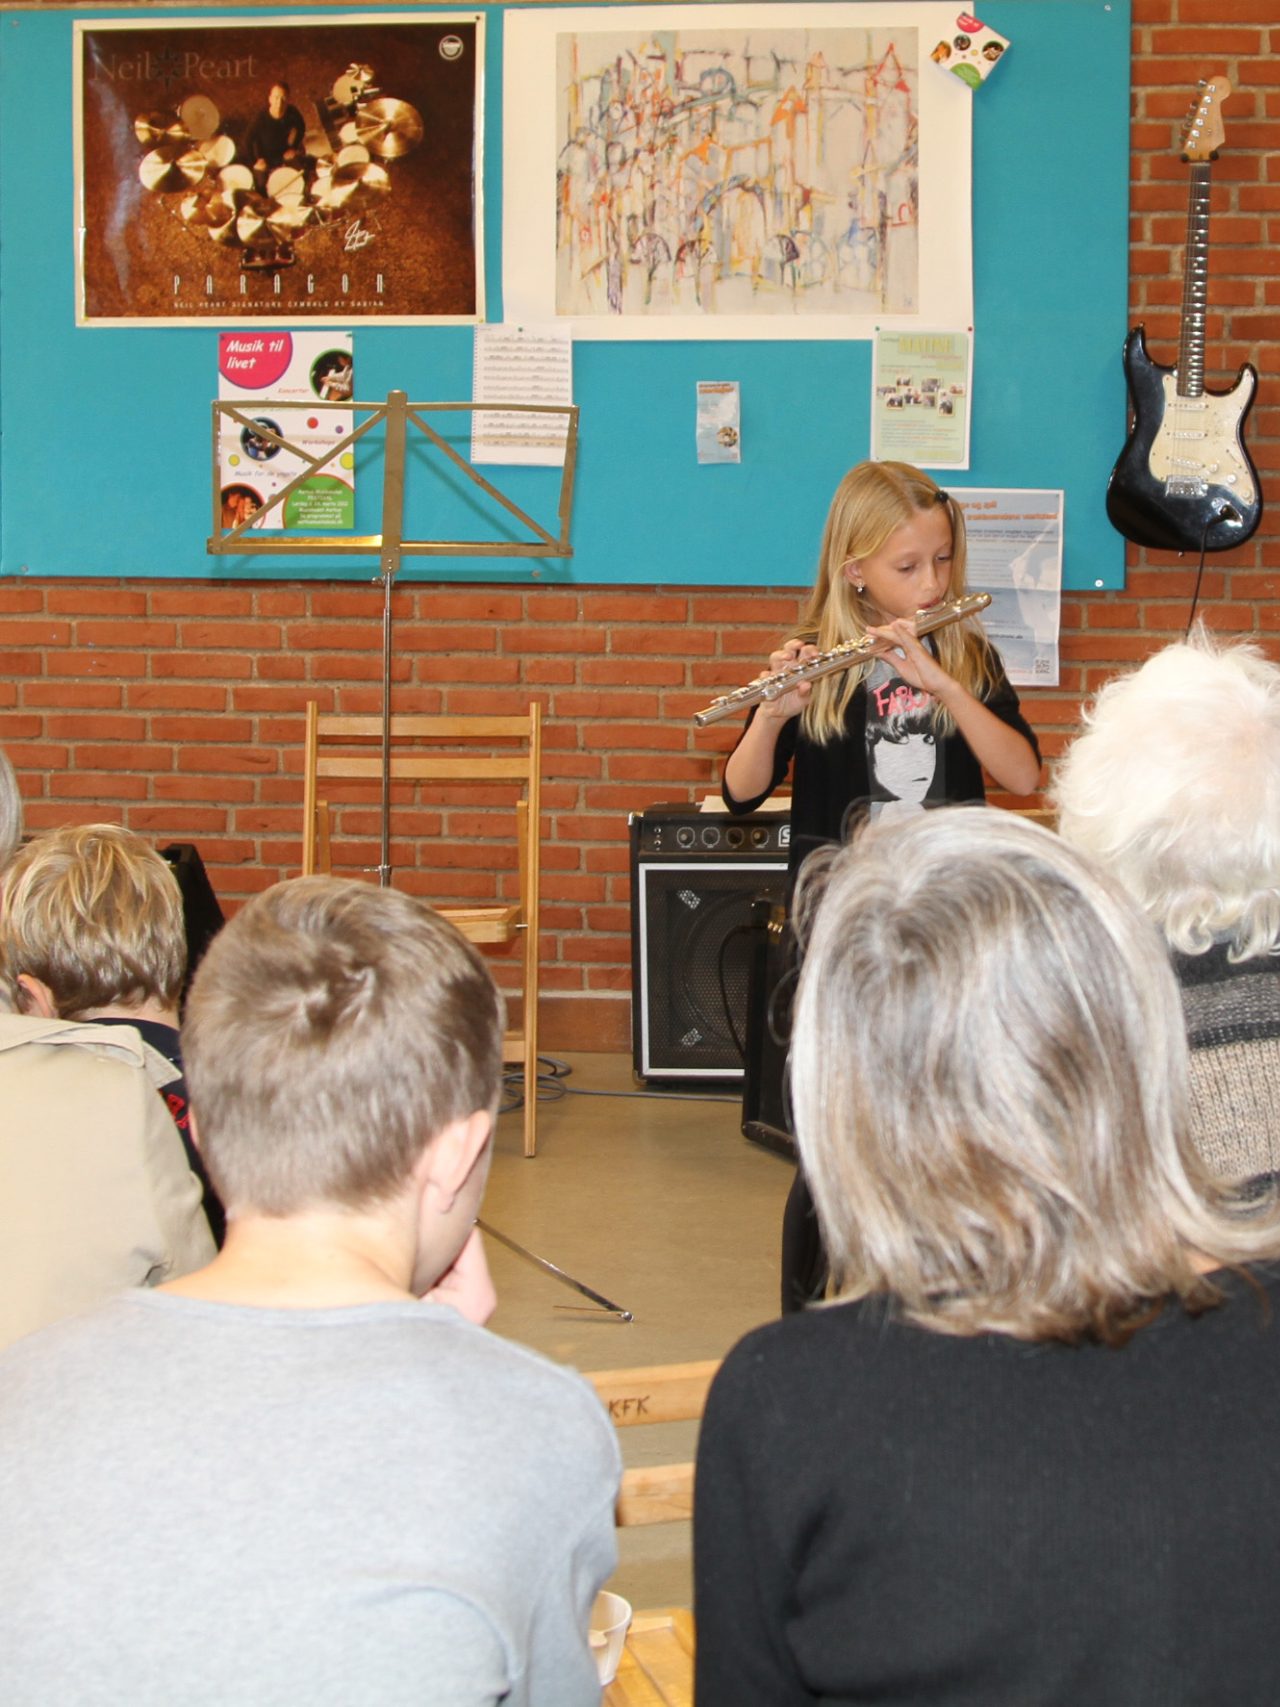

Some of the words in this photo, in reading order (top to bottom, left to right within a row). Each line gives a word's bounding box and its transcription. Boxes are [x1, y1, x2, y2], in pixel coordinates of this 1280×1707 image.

[92, 50, 151, 81] Neil
[183, 51, 258, 80] Peart
[173, 273, 384, 295] PARAGON
[226, 339, 264, 352] Musik
[269, 339, 285, 352] til
[226, 357, 257, 369] livet
[608, 1395, 651, 1418] KFK
